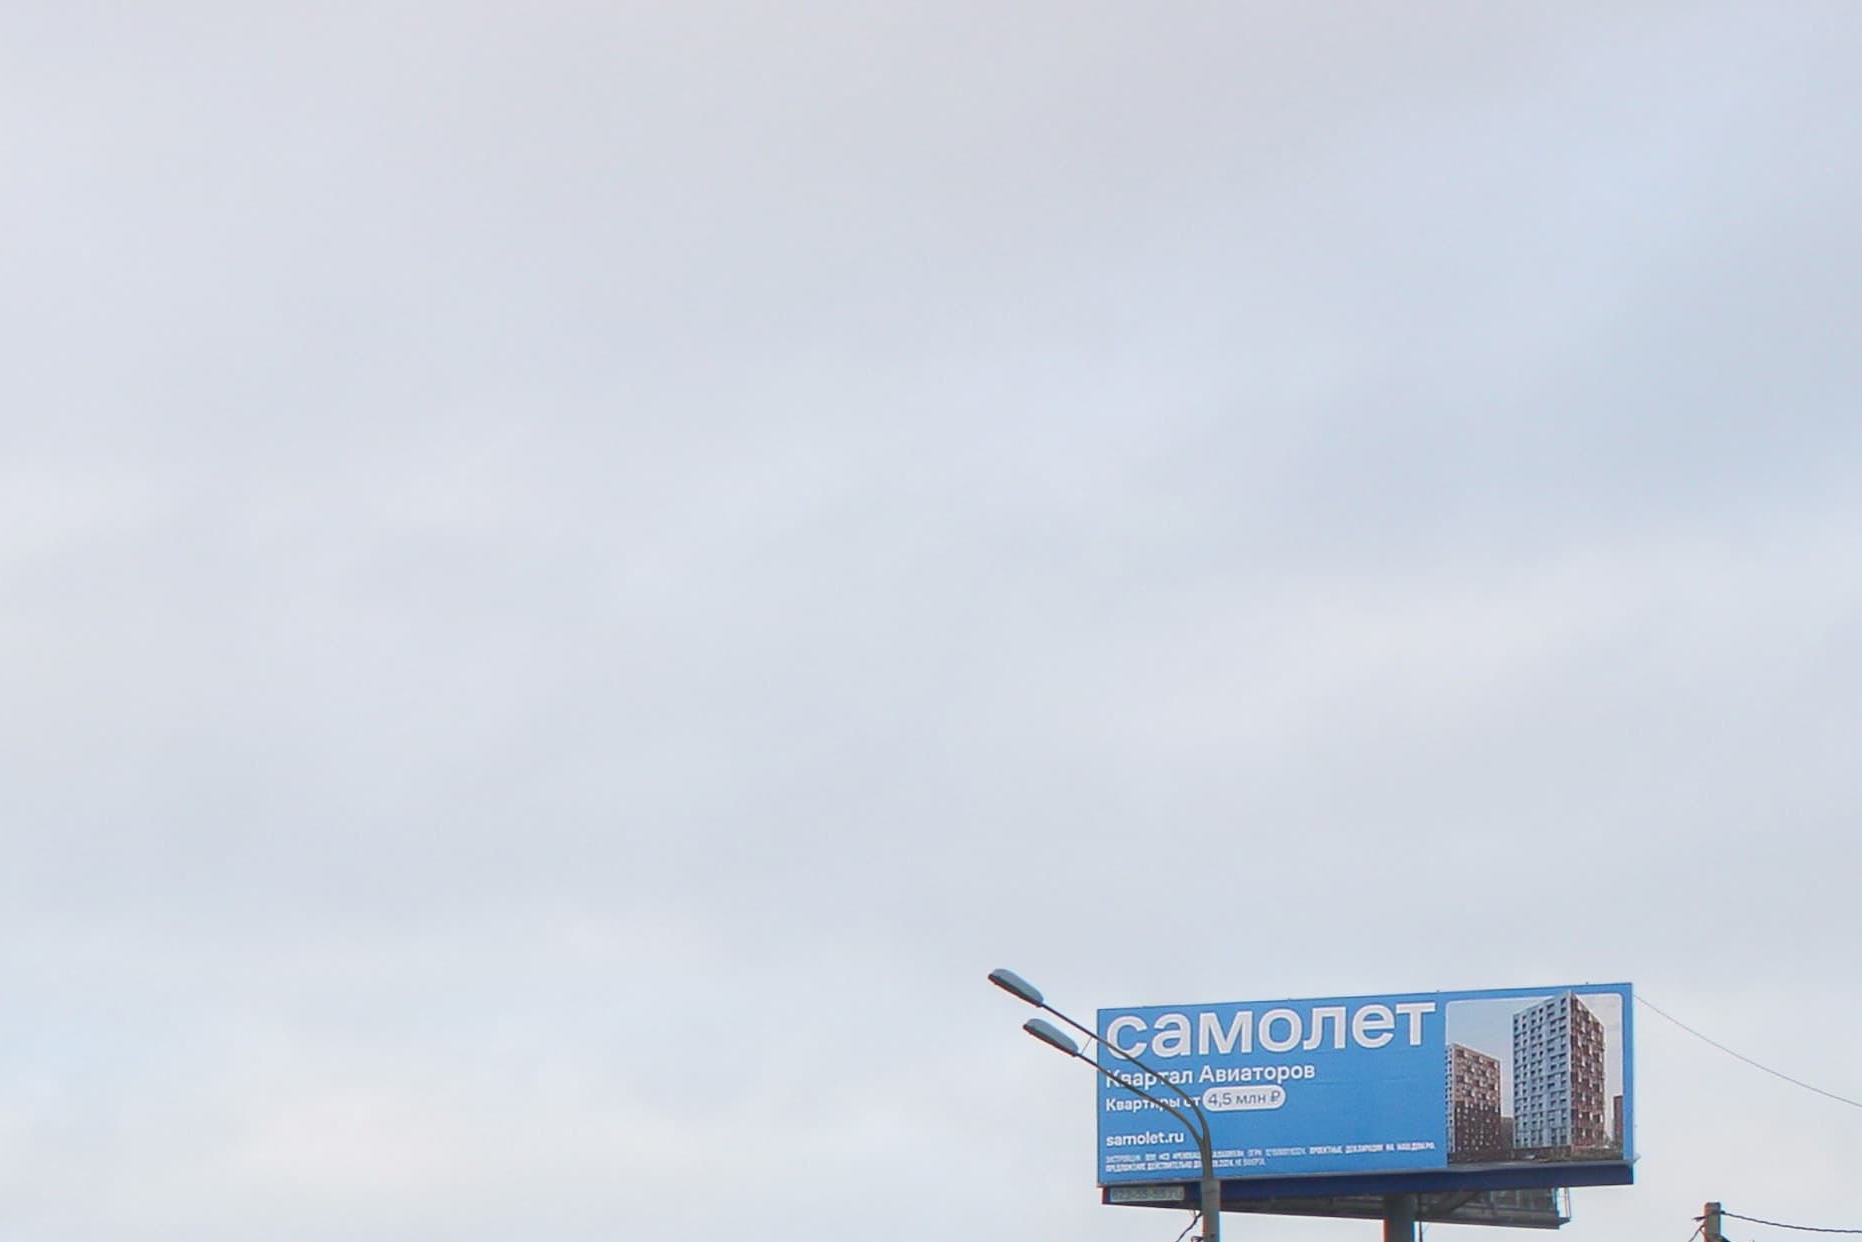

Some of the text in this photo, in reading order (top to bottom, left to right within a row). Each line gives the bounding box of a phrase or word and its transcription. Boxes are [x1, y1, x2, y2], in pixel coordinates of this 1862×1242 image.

[1106, 1002, 1436, 1059] самолет
[1106, 1063, 1315, 1090] Квартал Авиаторов
[1208, 1092, 1232, 1107] 4,5
[1236, 1093, 1266, 1105] млн
[1106, 1131, 1185, 1146] samolet.ru
